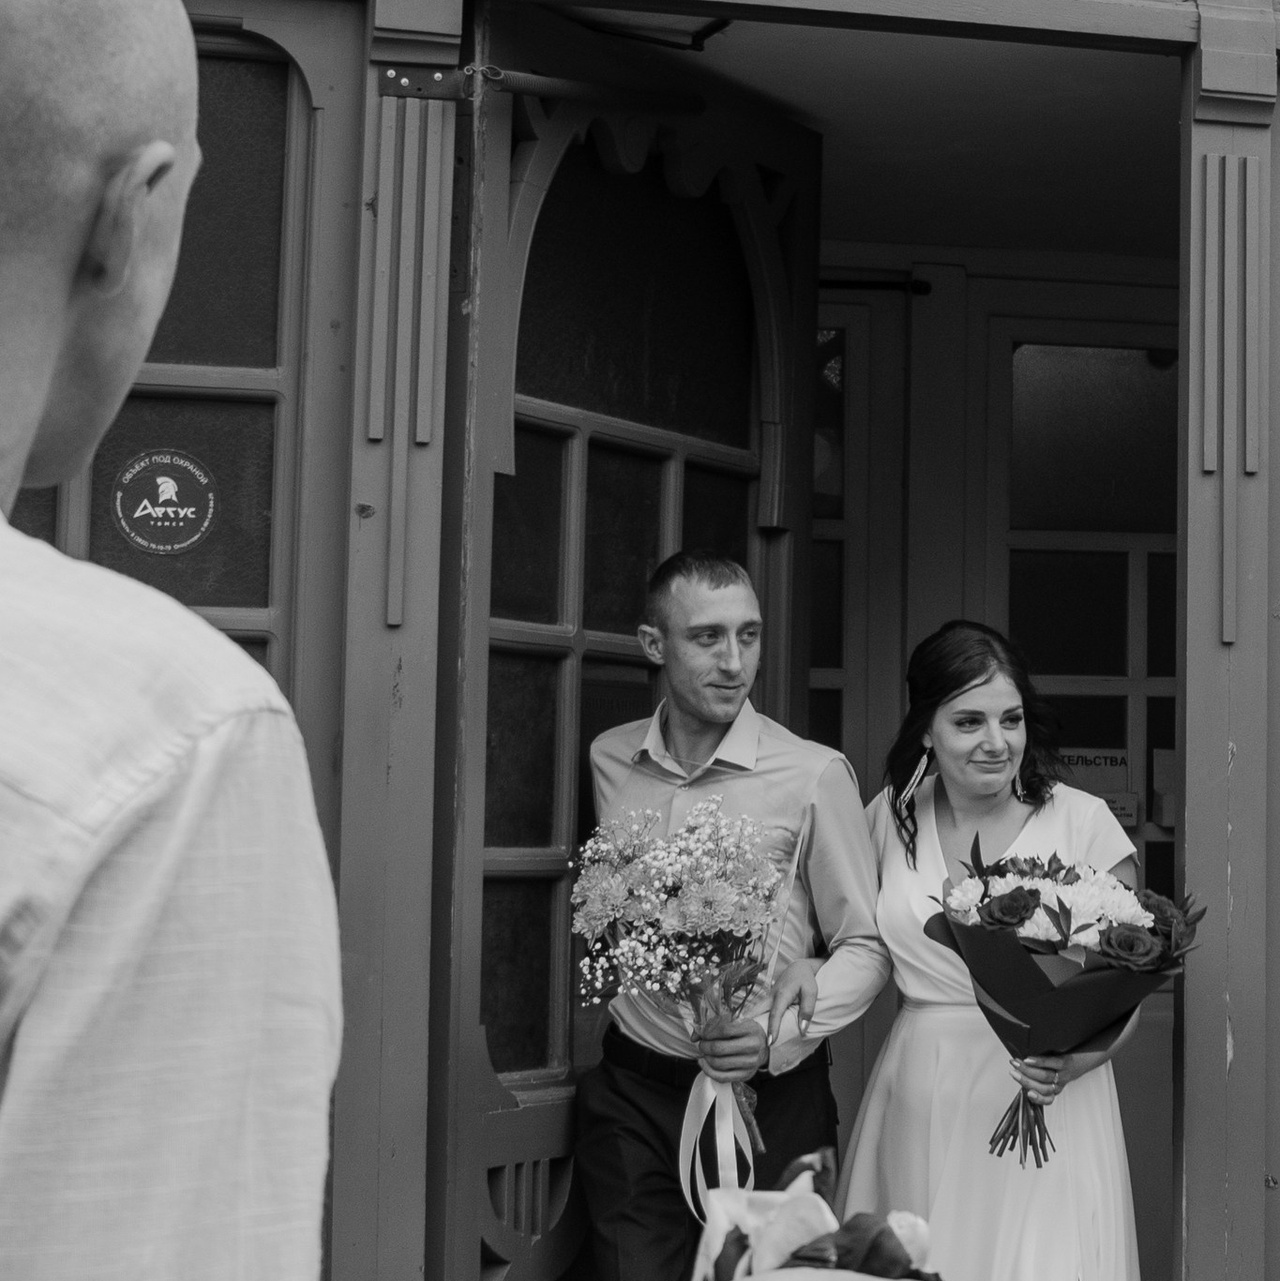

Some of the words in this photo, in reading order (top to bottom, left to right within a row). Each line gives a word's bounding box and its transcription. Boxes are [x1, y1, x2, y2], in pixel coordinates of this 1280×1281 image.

[122, 458, 150, 484] ОБЪЕКТ
[151, 455, 172, 464] ПОД
[172, 456, 209, 485] ОХРАНОЙ
